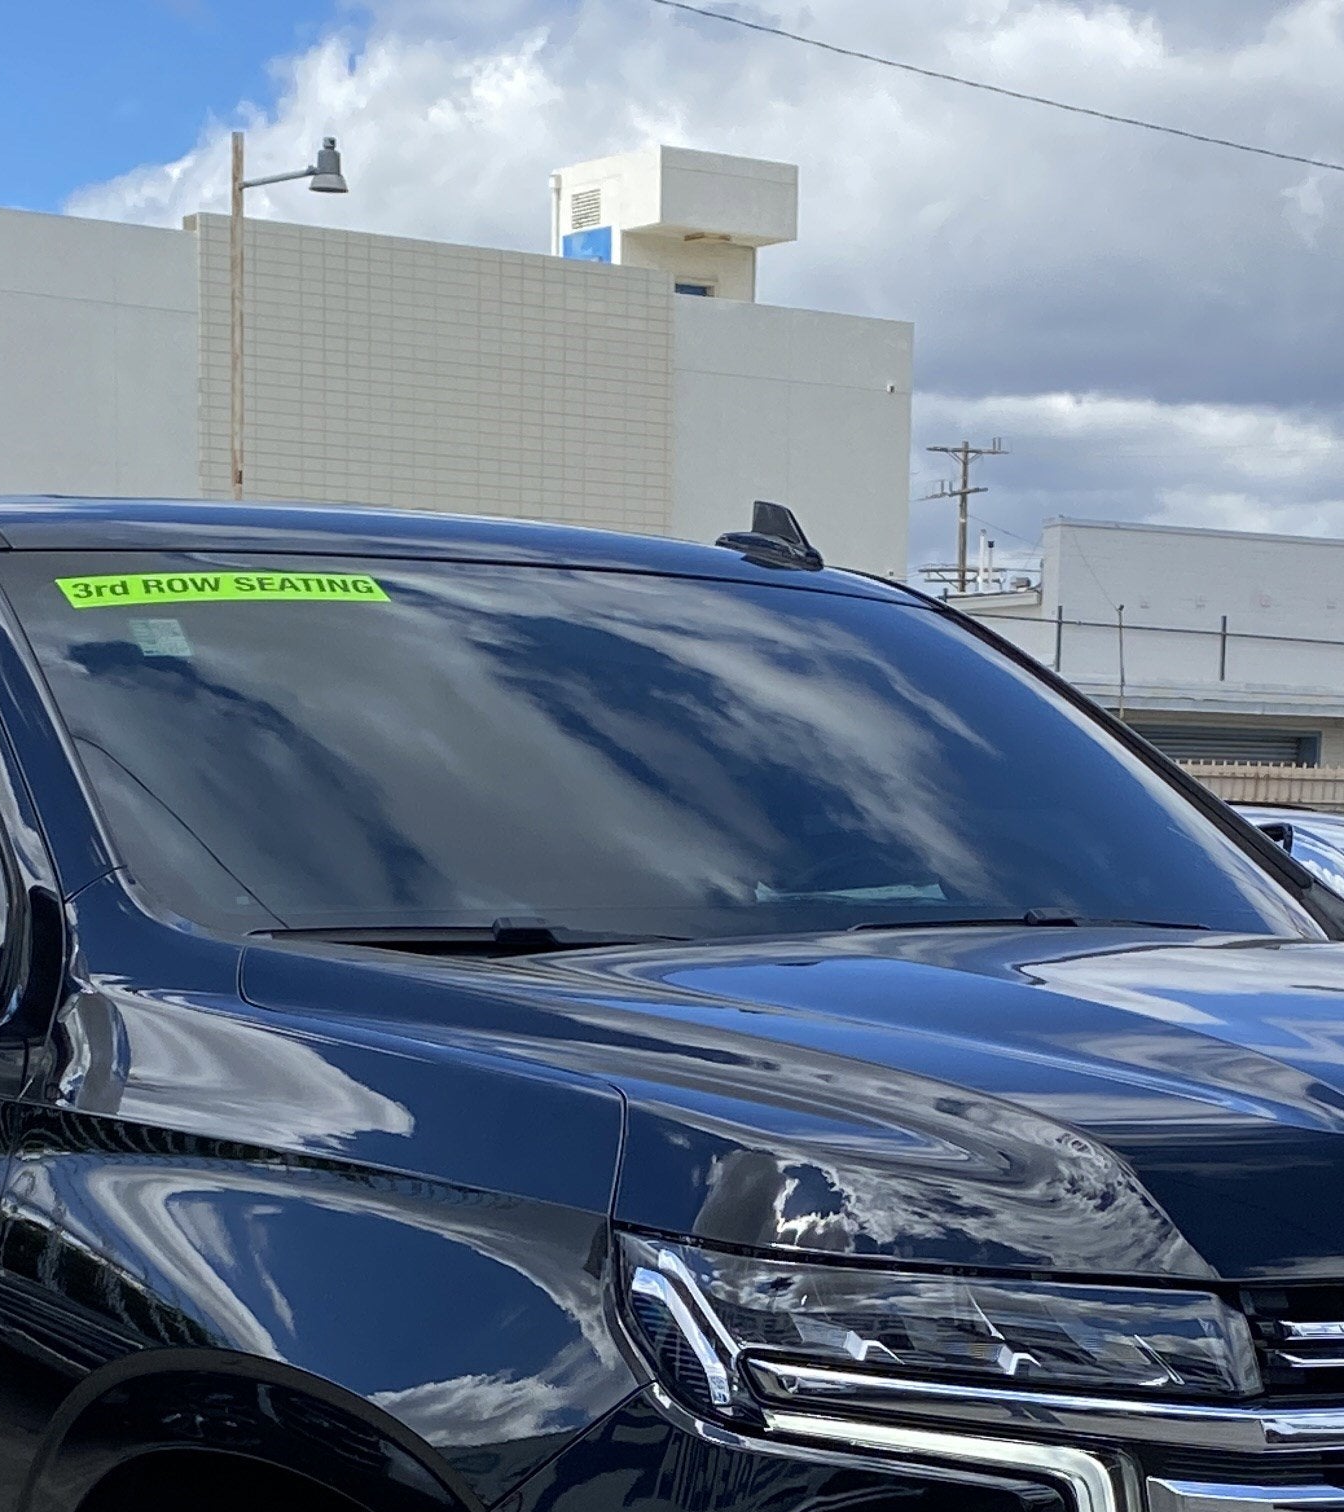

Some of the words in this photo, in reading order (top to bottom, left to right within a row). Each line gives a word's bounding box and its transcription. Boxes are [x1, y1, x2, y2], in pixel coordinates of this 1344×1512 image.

[72, 580, 129, 598] 3rd
[142, 577, 220, 594] ROW
[234, 577, 374, 593] SEATING
